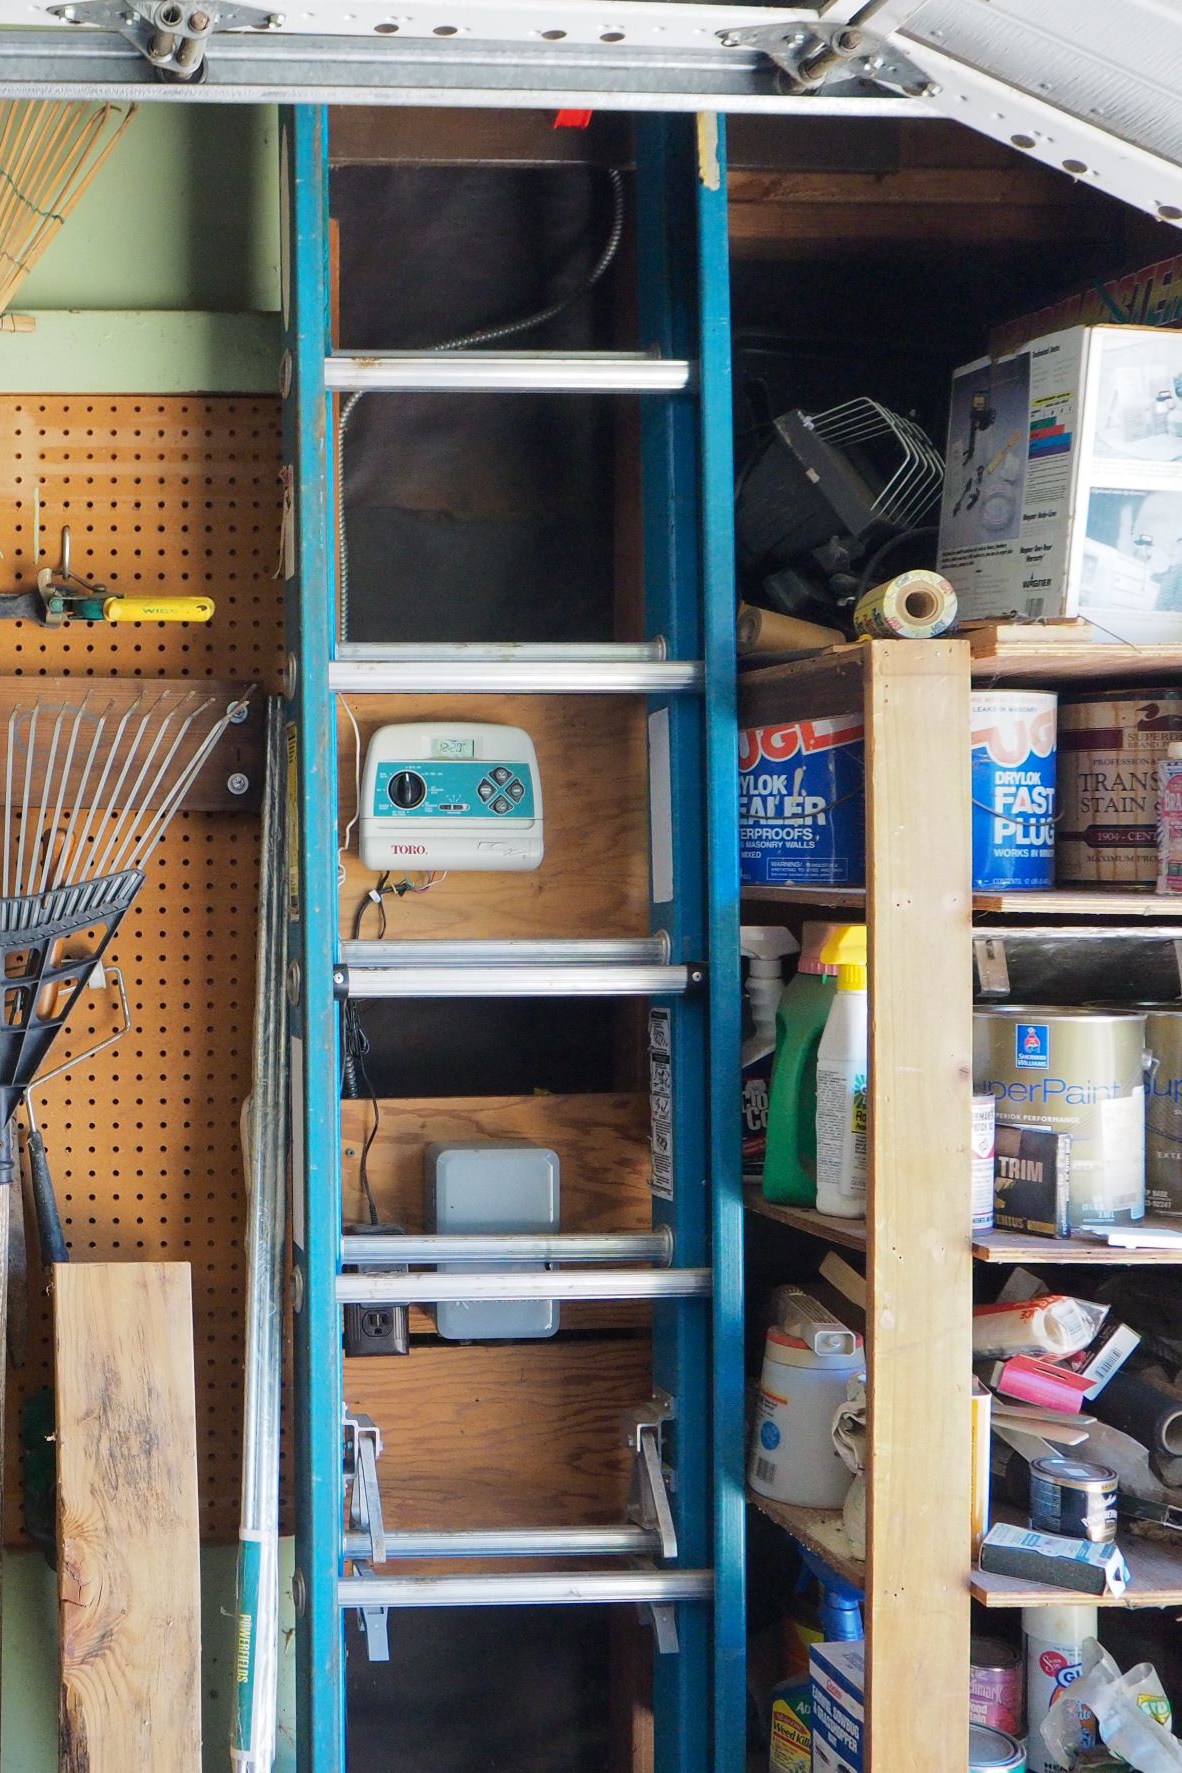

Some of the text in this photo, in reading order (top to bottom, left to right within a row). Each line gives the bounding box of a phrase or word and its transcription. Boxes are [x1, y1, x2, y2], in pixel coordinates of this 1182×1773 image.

[1093, 758, 1159, 767] PROFESSIONA
[739, 774, 787, 795] YLOK
[995, 771, 1041, 785] DRYLOK
[994, 786, 1054, 815] FAST
[1081, 797, 1146, 813] STAIN
[739, 796, 826, 825] EALER
[740, 828, 813, 840] ERPROOFS
[994, 817, 1054, 845] PLUG
[1127, 831, 1157, 841] CENT
[994, 848, 1029, 857] WORKS
[983, 1078, 1121, 1104] perPaint
[1023, 1114, 1081, 1124] PERFORMANCE
[998, 1156, 1044, 1183] TRIM
[237, 1614, 252, 1684] POWERFIELDS
[970, 1703, 988, 1714] ood
[970, 1712, 987, 1724] tain
[773, 1720, 796, 1740] Weed
